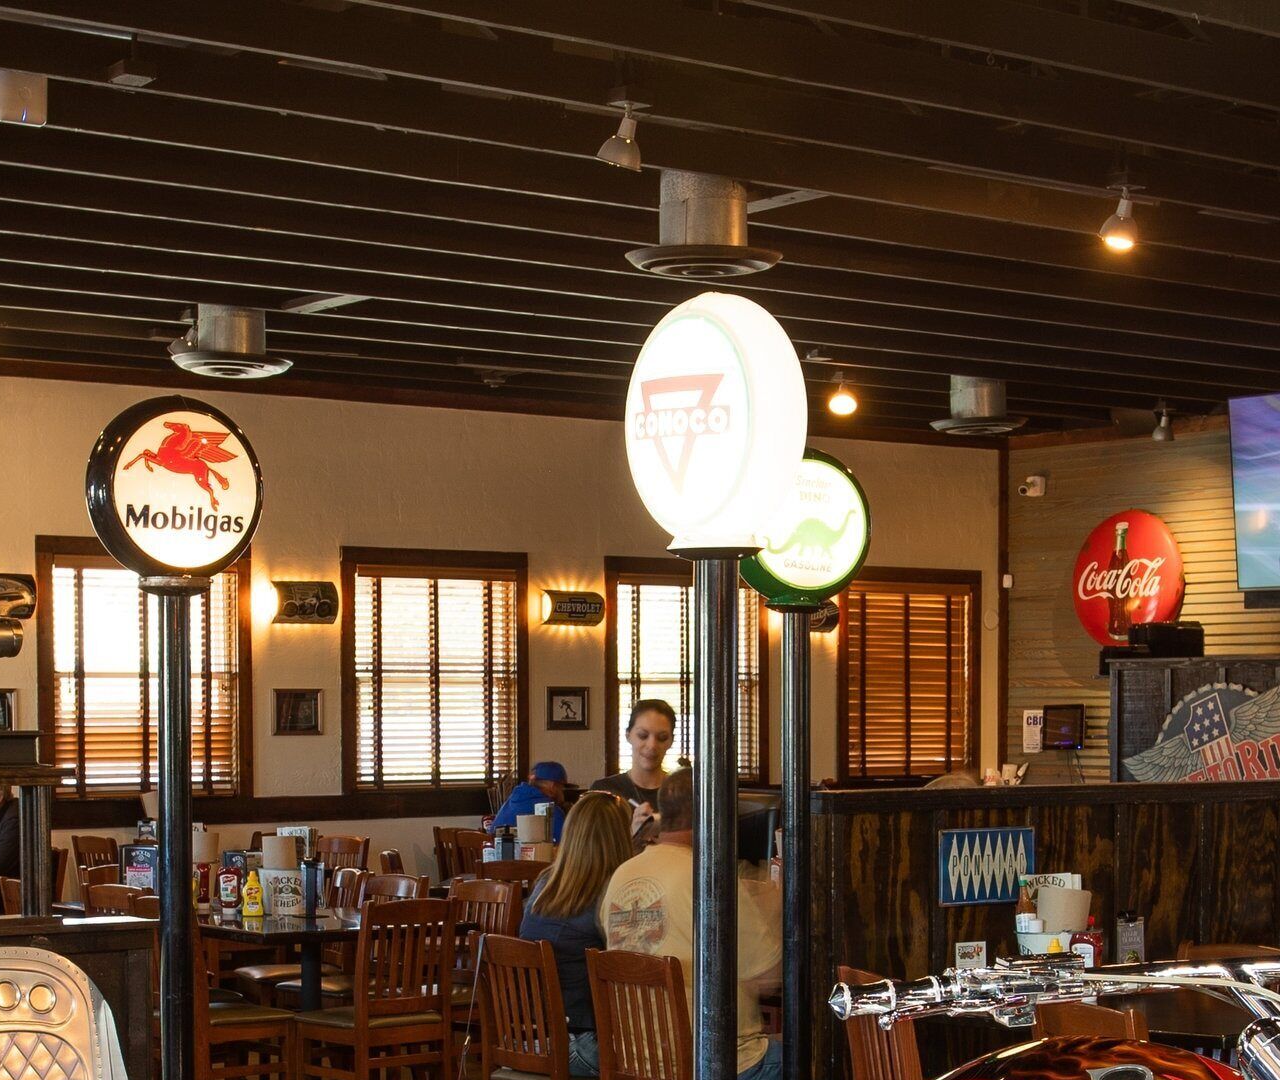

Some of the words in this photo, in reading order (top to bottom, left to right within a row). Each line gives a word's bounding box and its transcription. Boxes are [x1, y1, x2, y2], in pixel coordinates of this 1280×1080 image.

[635, 407, 729, 439] CONOCO
[125, 503, 244, 540] Mobilgas
[783, 558, 832, 573] GASOLINE
[1078, 557, 1167, 600] Coca-Cola
[556, 602, 601, 613] CHEVROLET
[951, 852, 1026, 877] PONTIAC
[1026, 875, 1066, 890] WICKED
